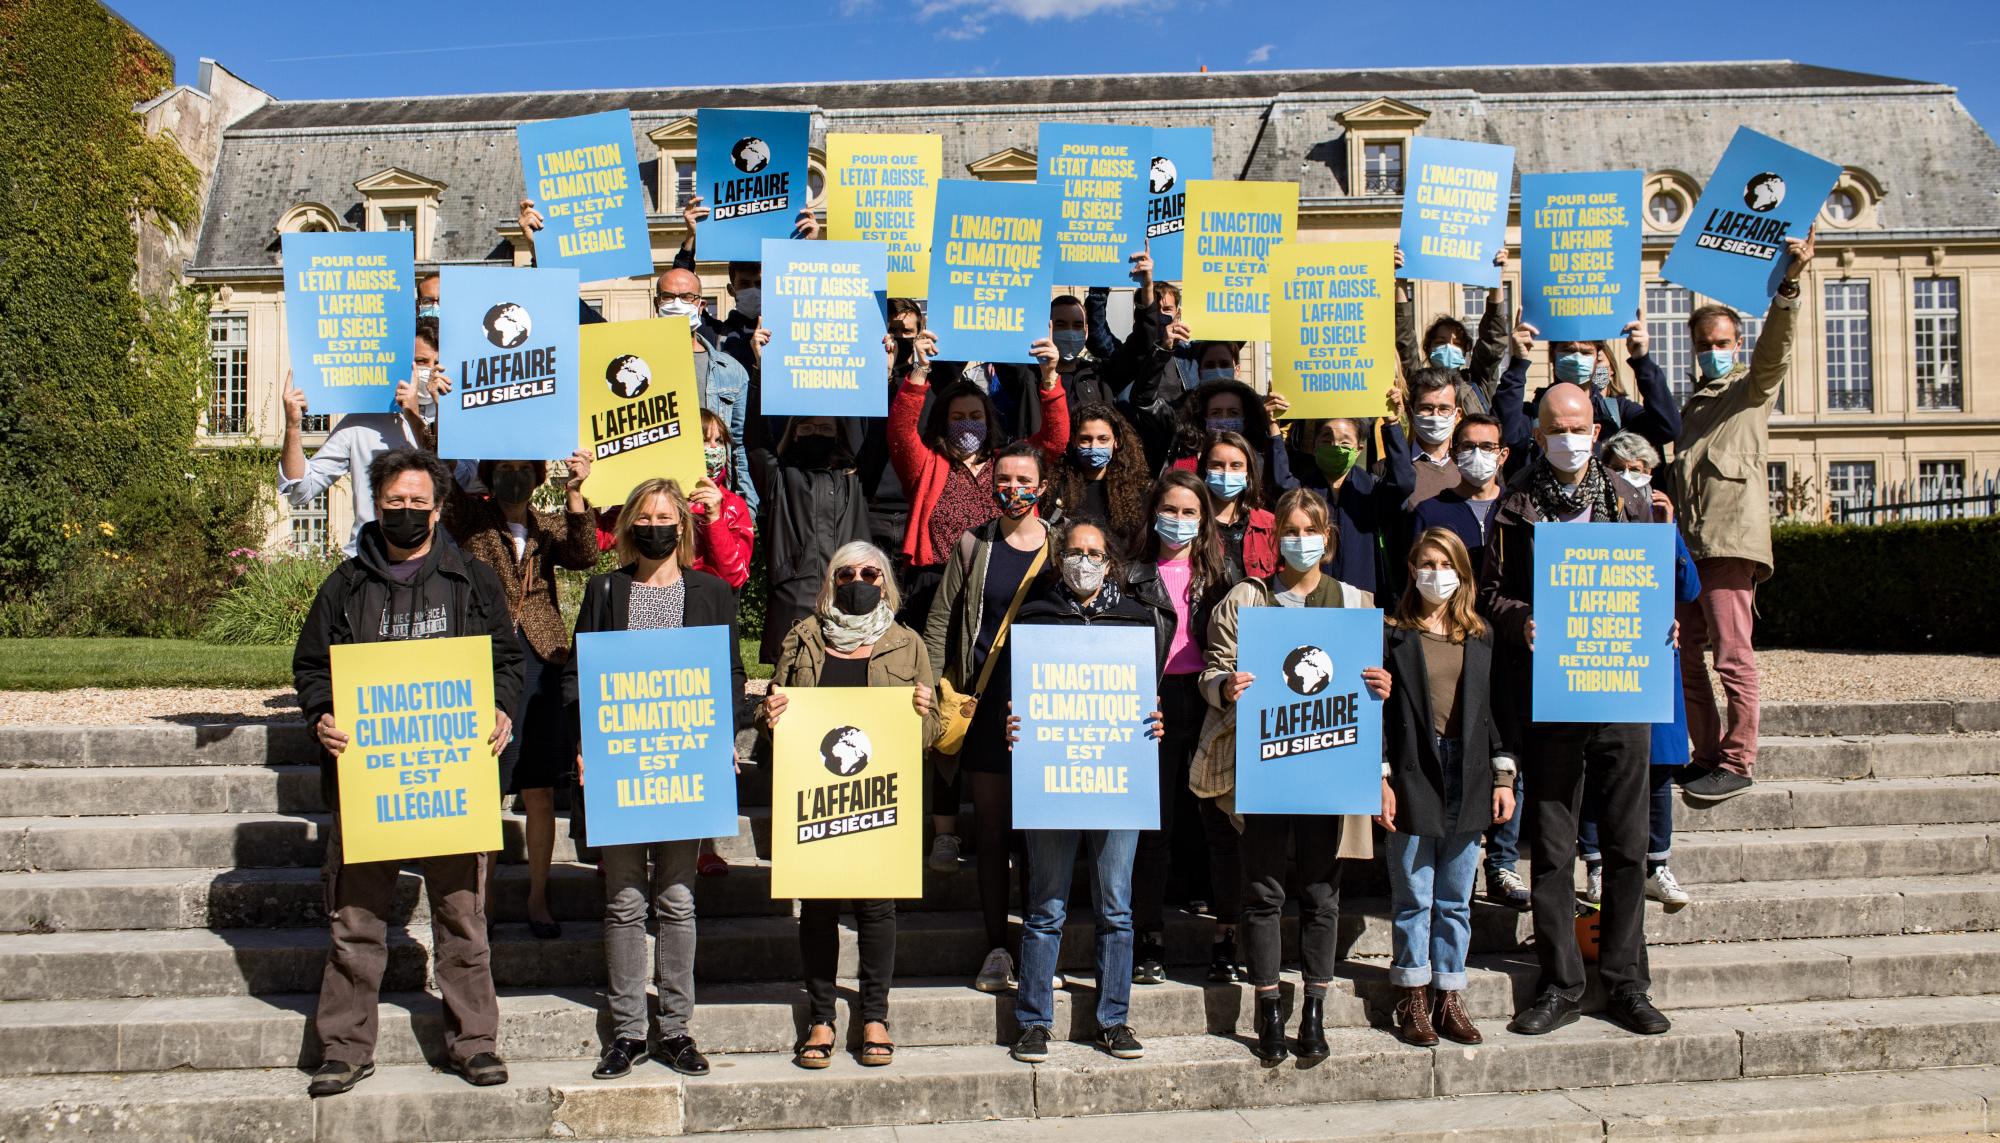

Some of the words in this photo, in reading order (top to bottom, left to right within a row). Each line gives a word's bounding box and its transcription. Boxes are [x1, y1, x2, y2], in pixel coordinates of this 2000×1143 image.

[538, 144, 621, 176] L'INACTION
[853, 155, 889, 166] POUR
[892, 156, 918, 166] QUE
[1063, 145, 1099, 156] POUR
[1102, 146, 1128, 157] QUE
[841, 165, 878, 187] L'ÉTAT
[881, 168, 929, 189] AGISSE,
[1051, 154, 1088, 177] L'ÉTAT
[1090, 159, 1138, 181] AGISSE,
[1422, 166, 1498, 190] L'INACTION
[539, 167, 628, 201] CLIMATIQUE
[714, 172, 789, 204] L'AFFAIRE
[1065, 180, 1122, 199] L'AFFAIRE
[549, 204, 569, 216] DE
[572, 196, 625, 214] L'ÉTAT
[716, 206, 735, 219] DU
[738, 198, 787, 215] SIÈCLE
[857, 190, 914, 208] L'AFFAIRE
[1062, 201, 1080, 218] DU
[1082, 199, 1123, 220] SIÈCLE
[1417, 185, 1498, 213] CLIMATIQUE
[1548, 194, 1586, 206] POUR
[1589, 193, 1618, 205] QUE
[573, 213, 603, 228] EST
[855, 212, 872, 229] DU
[875, 208, 916, 229] SIÈCLE
[1070, 220, 1094, 231] EST
[1097, 221, 1115, 231] DE
[1201, 212, 1282, 234] L'INACTION
[1420, 208, 1439, 220] DE
[1443, 210, 1490, 226] L'ÉTAT
[1536, 206, 1575, 229] L'ÉTAT
[1578, 206, 1629, 228] AGISSE,
[1704, 208, 1792, 244] L'AFFAIRE
[863, 231, 888, 241] EST
[891, 231, 908, 241] DE
[951, 215, 1042, 242] L'INACTION
[1109, 233, 1127, 243] AU
[1148, 219, 1184, 237] SIÈCL
[1440, 222, 1467, 235] EST
[558, 229, 626, 256] ILLÉGALE
[904, 243, 921, 253] AU
[1421, 235, 1482, 260] ILLÉGALE
[1552, 230, 1612, 250] L'AFFAIRE
[1698, 235, 1722, 248] DU
[1721, 239, 1776, 259] SIÈCLE
[312, 255, 354, 268] POUR
[357, 254, 388, 267] QUE
[946, 241, 1043, 273] CLIMATIQUE
[1060, 244, 1121, 264] TRIBUNAL
[1550, 253, 1568, 272] DU
[1571, 250, 1614, 271] SIÈCLE
[790, 262, 829, 274] POUR
[832, 263, 861, 275] QUE
[1203, 262, 1223, 273] DE
[1227, 261, 1269, 275] L'ÉTA
[1297, 266, 1336, 278] POUR
[1339, 265, 1368, 276] QUE
[1559, 273, 1584, 284] EST
[1588, 272, 1606, 283] DE
[300, 267, 344, 292] L'ÉTAT
[346, 269, 402, 293] AGISSE,
[777, 272, 818, 296] L'ÉTAT
[821, 277, 874, 300] AGISSE,
[951, 272, 974, 285] DE
[978, 271, 1034, 288] L'ÉTAT
[1224, 276, 1253, 288] EST
[1285, 277, 1325, 301] L'ÉTAT
[1328, 278, 1381, 300] AGISSE,
[1544, 284, 1599, 296] RETOUR
[1601, 284, 1620, 294] AU
[320, 294, 385, 316] L'AFFAIRE
[974, 288, 1007, 302] EST
[1206, 288, 1270, 314] ILLÉGALE
[794, 299, 856, 320] L'AFFAIRE
[953, 302, 1025, 331] ILLÉGALE
[1302, 302, 1364, 323] L'AFFAIRE
[1550, 296, 1614, 317] TRIBUNAL
[319, 319, 339, 339] DU
[342, 316, 388, 338] SIÈCLE
[792, 322, 811, 341] DU
[814, 320, 859, 342] SIÈCLE
[1300, 326, 1319, 346] DU
[1322, 322, 1367, 345] SIÈCLE
[330, 340, 358, 351] EST
[361, 340, 381, 351] DE
[801, 343, 828, 354] EST
[832, 344, 851, 355] DE
[1310, 347, 1336, 358] EST
[1340, 346, 1359, 357] DE
[315, 352, 374, 364] RETOUR
[376, 352, 396, 363] AU
[462, 346, 556, 390] L'AFFAIRE
[786, 356, 844, 367] RETOUR
[846, 357, 865, 368] AU
[1295, 359, 1352, 371] RETOUR
[1354, 358, 1374, 370] AU
[323, 366, 390, 386] TRIBUNAL
[792, 369, 859, 390] TRIBUNAL
[1301, 372, 1368, 393] TRIBUNAL
[464, 391, 488, 407] DU
[492, 380, 553, 402] SIÈCLE
[592, 391, 679, 441] L'AFFAIRE
[597, 440, 619, 458] DU
[623, 423, 679, 450] SIÈCLE
[1566, 549, 1610, 561] POUR
[1613, 549, 1646, 561] QUE
[1552, 560, 1597, 587] L'ÉTAT
[1600, 565, 1659, 590] AGISSE,
[1570, 591, 1640, 613] L'AFFAIRE
[1568, 617, 1588, 638] DU
[1592, 613, 1642, 639] SIÈCLE
[1578, 640, 1608, 652] EST
[1611, 641, 1633, 653] DE
[1560, 655, 1625, 667] RETOUR
[1627, 655, 1649, 667] AU
[601, 667, 711, 702] L'INACTION
[1033, 664, 1137, 691] L'INACTION
[1567, 670, 1642, 693] TRIBUNAL
[357, 680, 473, 714] L'INACTION
[598, 697, 716, 734] CLIMATIQUE
[1029, 692, 1141, 726] CLIMATIQUE
[1261, 693, 1358, 739] L'AFFAIRE
[355, 710, 478, 748] CLIMATIQUE
[1038, 727, 1064, 741] DE
[1069, 725, 1135, 742] L'ÉTAT
[609, 739, 636, 754] DE
[641, 734, 710, 753] L'ÉTAT
[1067, 745, 1104, 760] EST
[1263, 741, 1288, 758] DU
[1291, 729, 1355, 752] SIÈCLE
[366, 754, 395, 769] DE
[401, 747, 472, 767] L'ÉTAT
[640, 754, 679, 771] EST
[400, 768, 440, 786] EST
[1045, 761, 1128, 793] ILLÉGALE
[618, 772, 705, 807] ILLÉGALE
[798, 772, 897, 822] L'AFFAIRE
[376, 788, 467, 822] ILLÉGALE
[800, 823, 825, 841] DU
[829, 809, 895, 835] SIÈCLE
